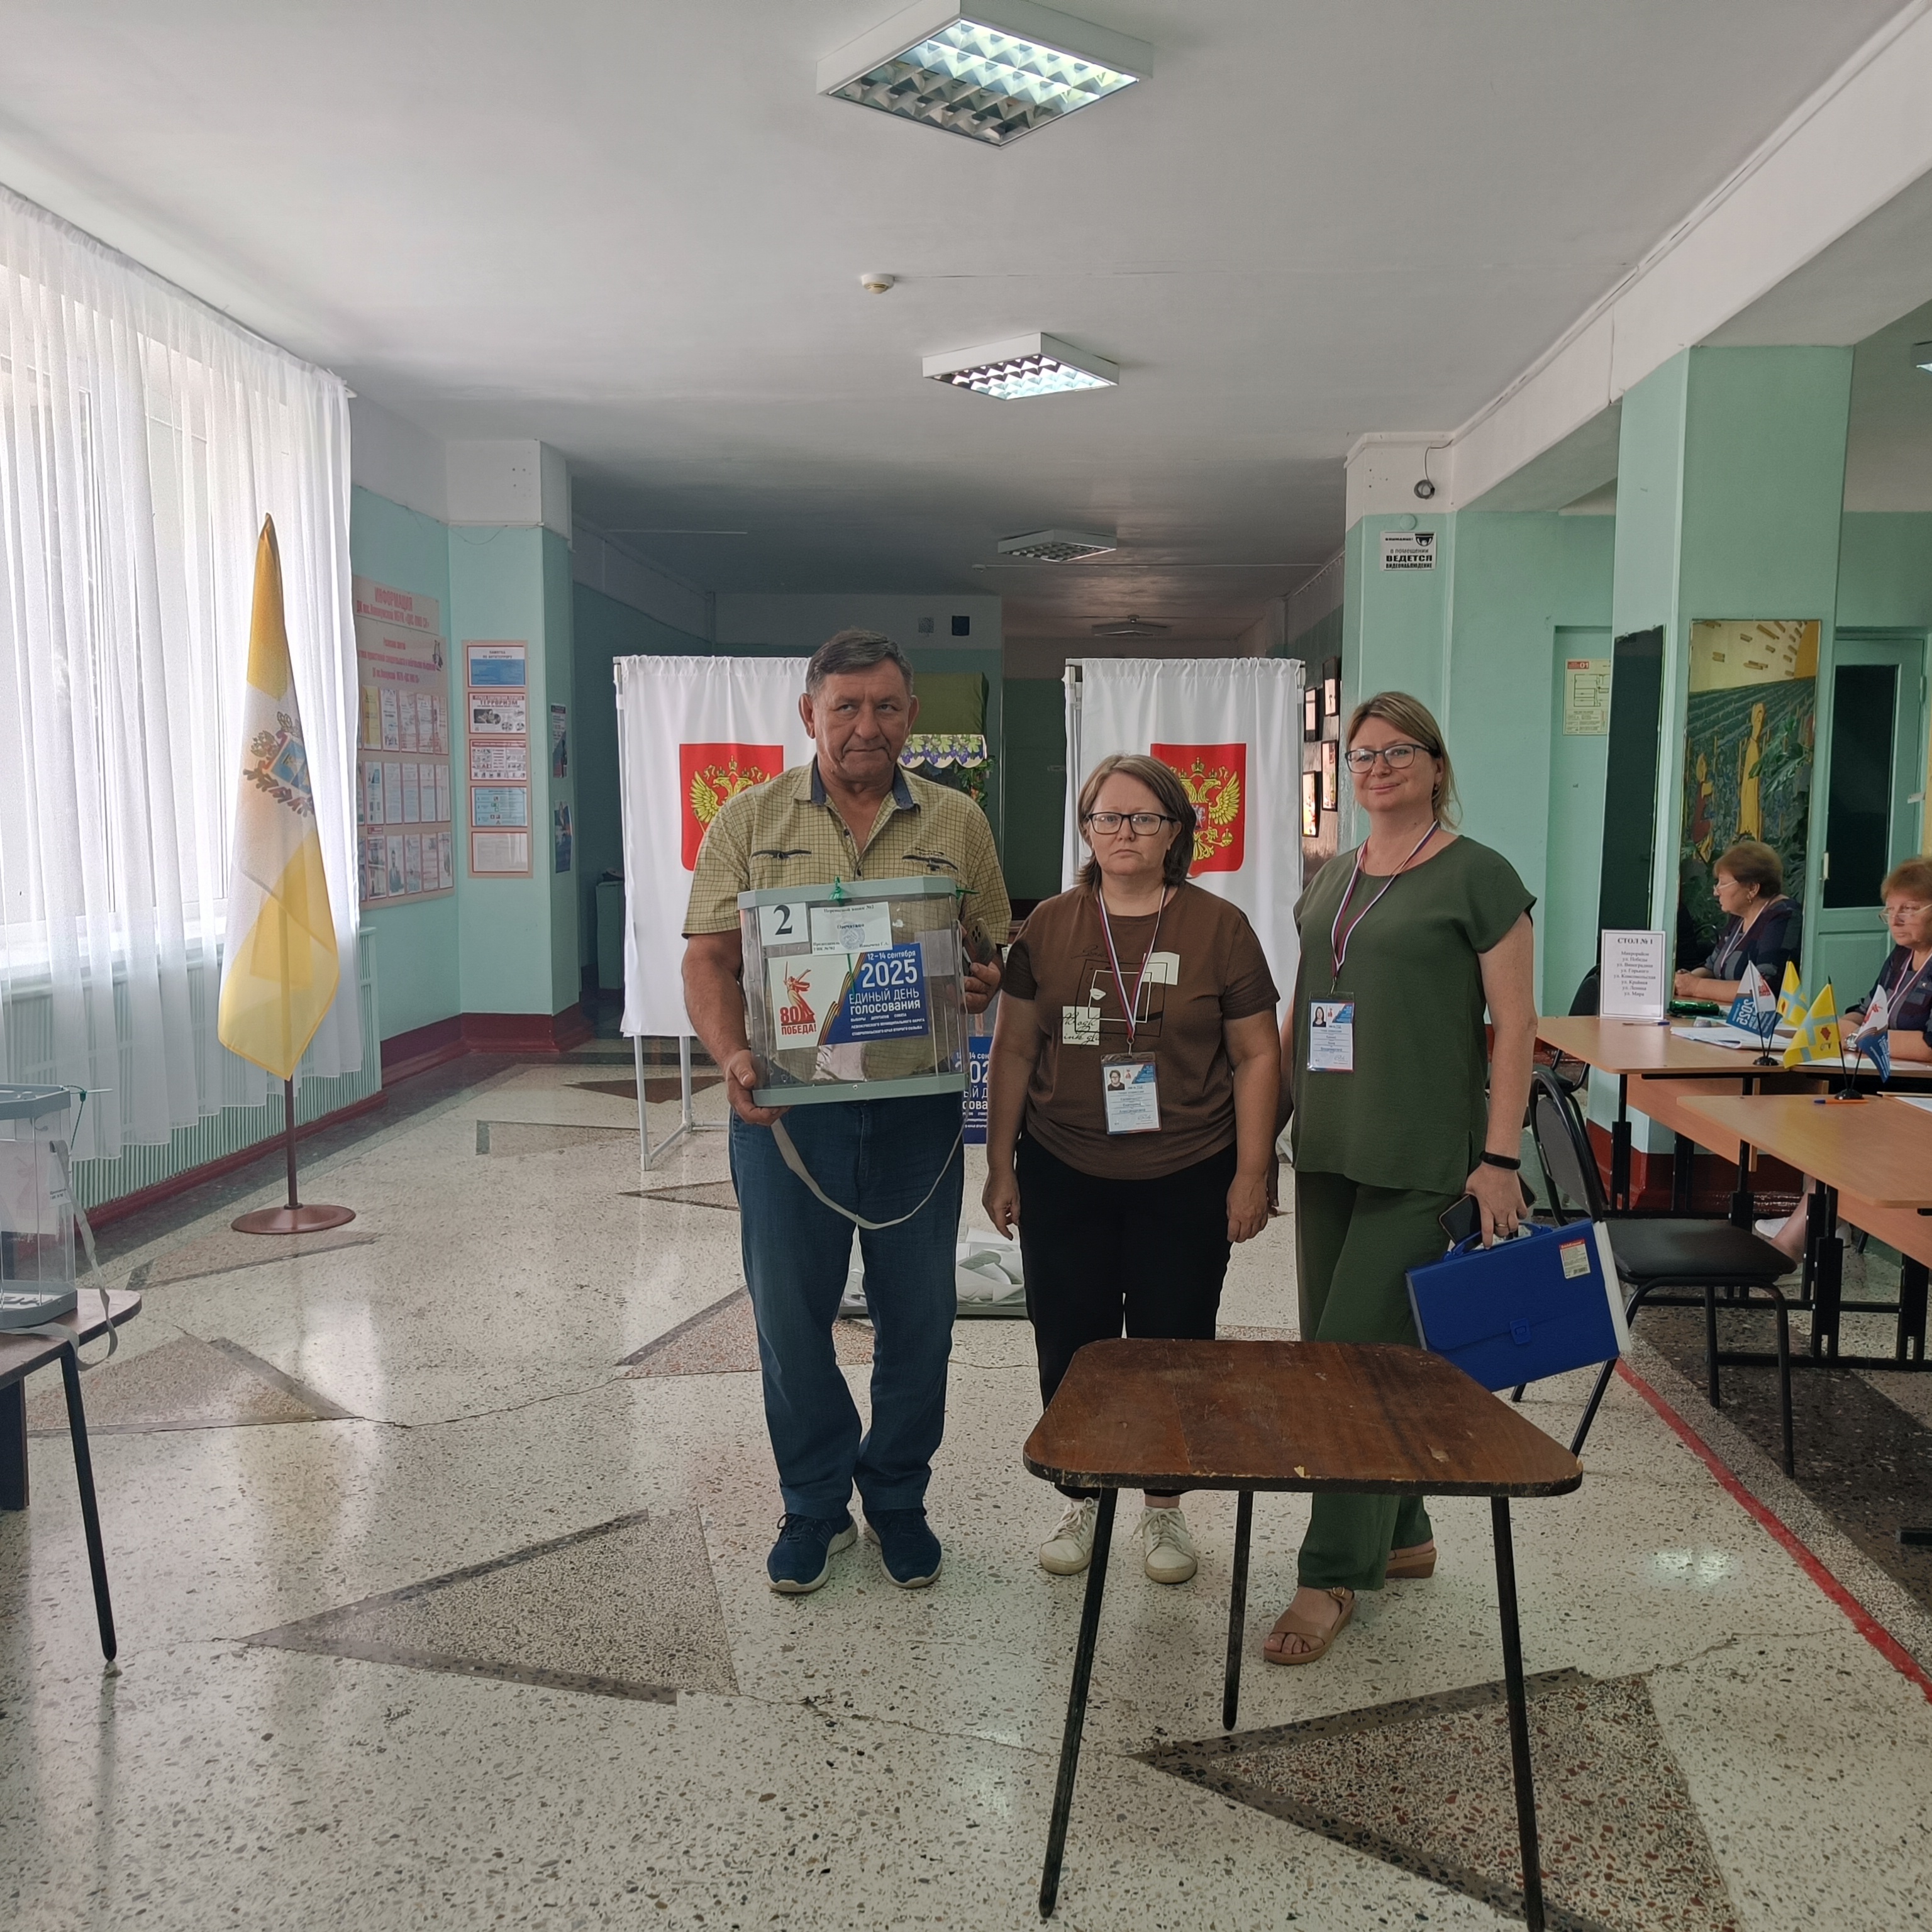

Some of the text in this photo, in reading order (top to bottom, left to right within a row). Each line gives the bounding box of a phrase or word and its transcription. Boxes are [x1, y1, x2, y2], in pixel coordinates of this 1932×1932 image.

[774, 904, 793, 935] 2
[887, 950, 916, 959] сентября
[861, 958, 918, 988] 2025
[849, 987, 919, 1004] ЕДИНЫЙ ДЕНЬ
[780, 1006, 799, 1024] 80
[781, 1024, 816, 1035] ПОБЕДА!
